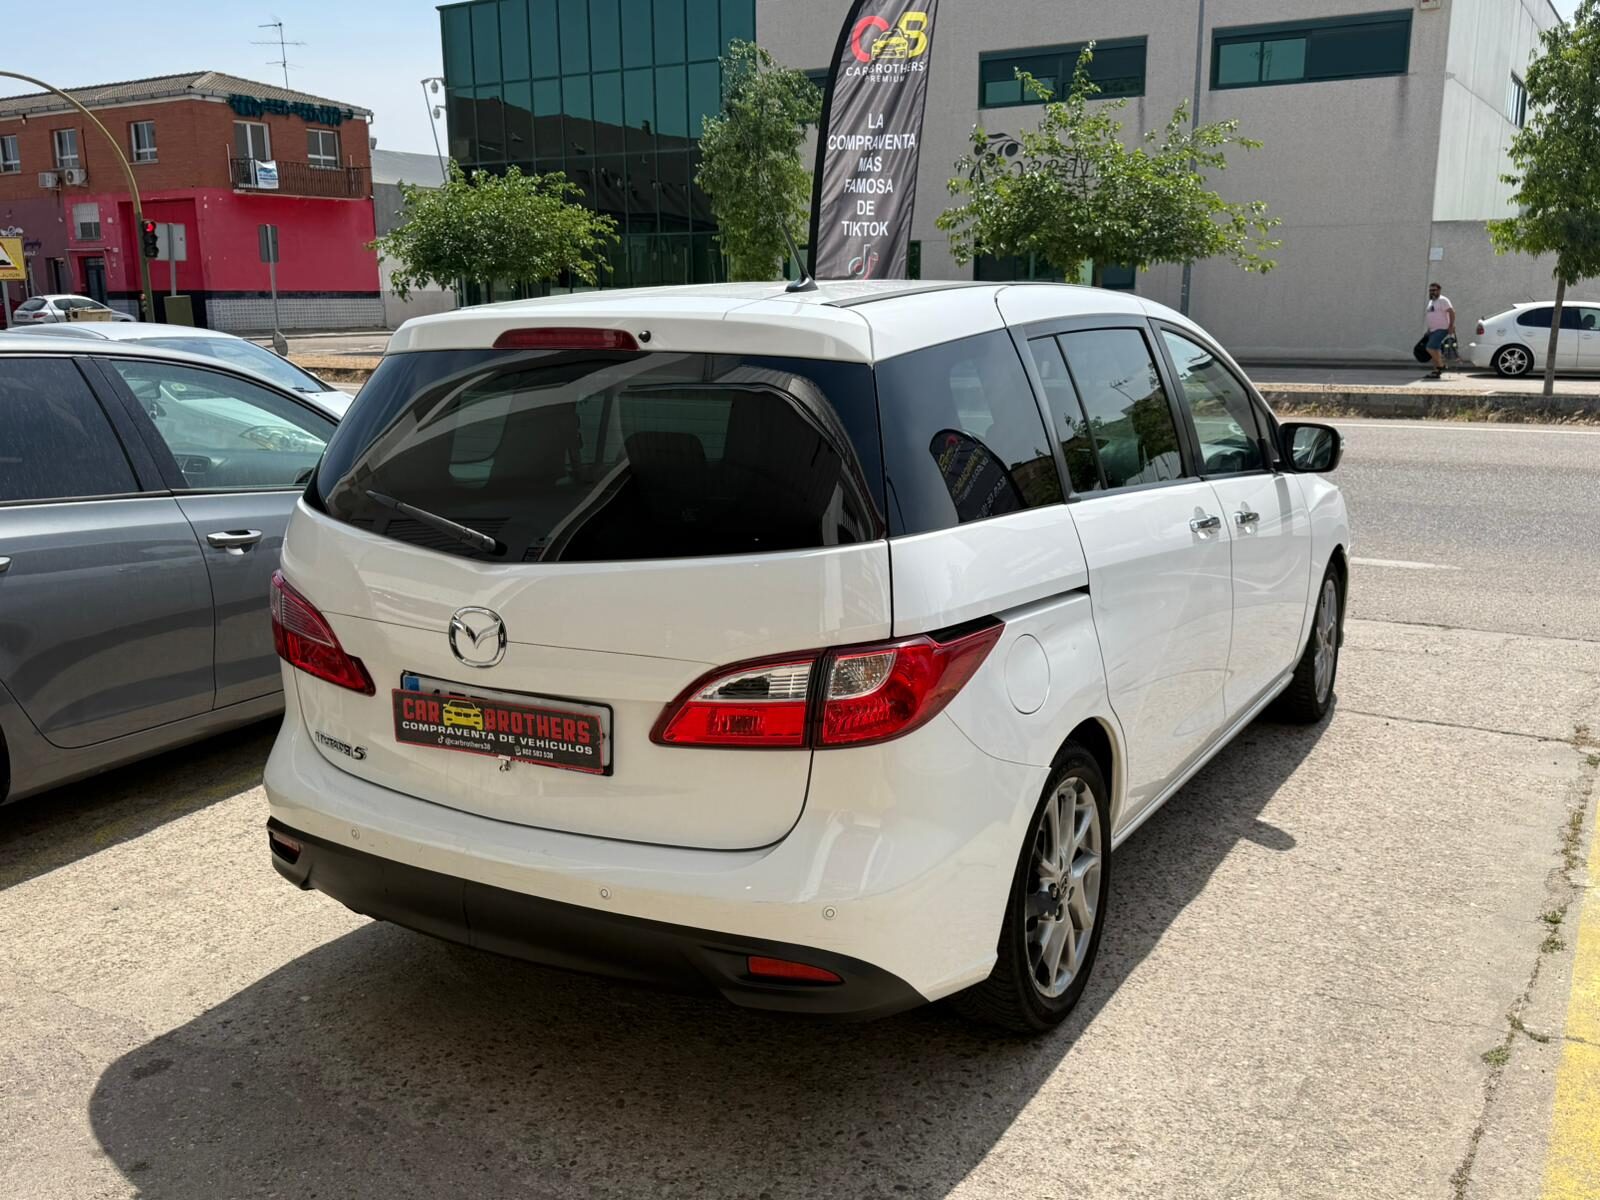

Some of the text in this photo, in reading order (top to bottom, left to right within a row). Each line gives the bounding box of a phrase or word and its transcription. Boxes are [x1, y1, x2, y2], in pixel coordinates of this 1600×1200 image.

[868, 113, 884, 129] LA
[828, 133, 916, 150] COMPRAVENTA
[843, 178, 894, 194] FAMOSA
[857, 200, 875, 215] DE
[841, 220, 889, 237] TIKTOK
[402, 698, 591, 744] CAR BROTHERS
[402, 721, 496, 741] COMPRAVENTA
[499, 732, 516, 744] DE
